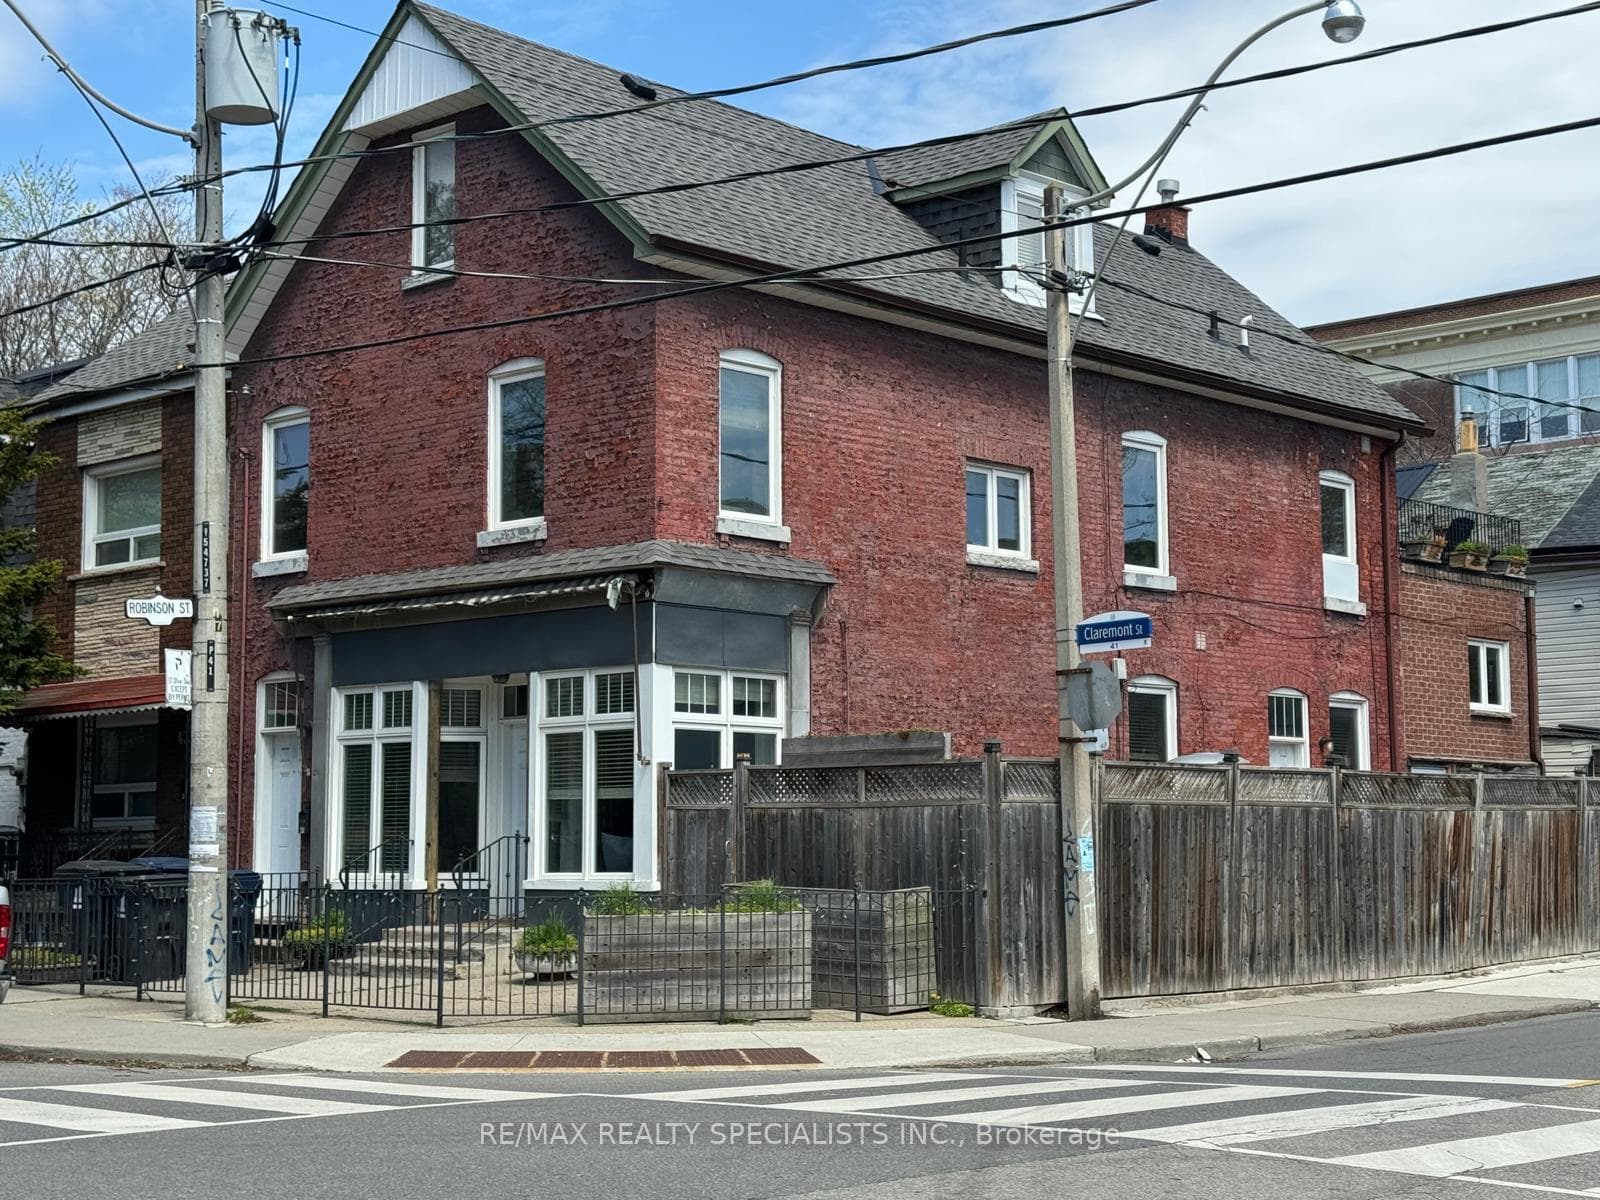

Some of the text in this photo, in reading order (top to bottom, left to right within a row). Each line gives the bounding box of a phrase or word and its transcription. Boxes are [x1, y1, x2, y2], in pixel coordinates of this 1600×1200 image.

[129, 602, 175, 614] ROBINSON
[1084, 623, 1143, 641] Claremont St
